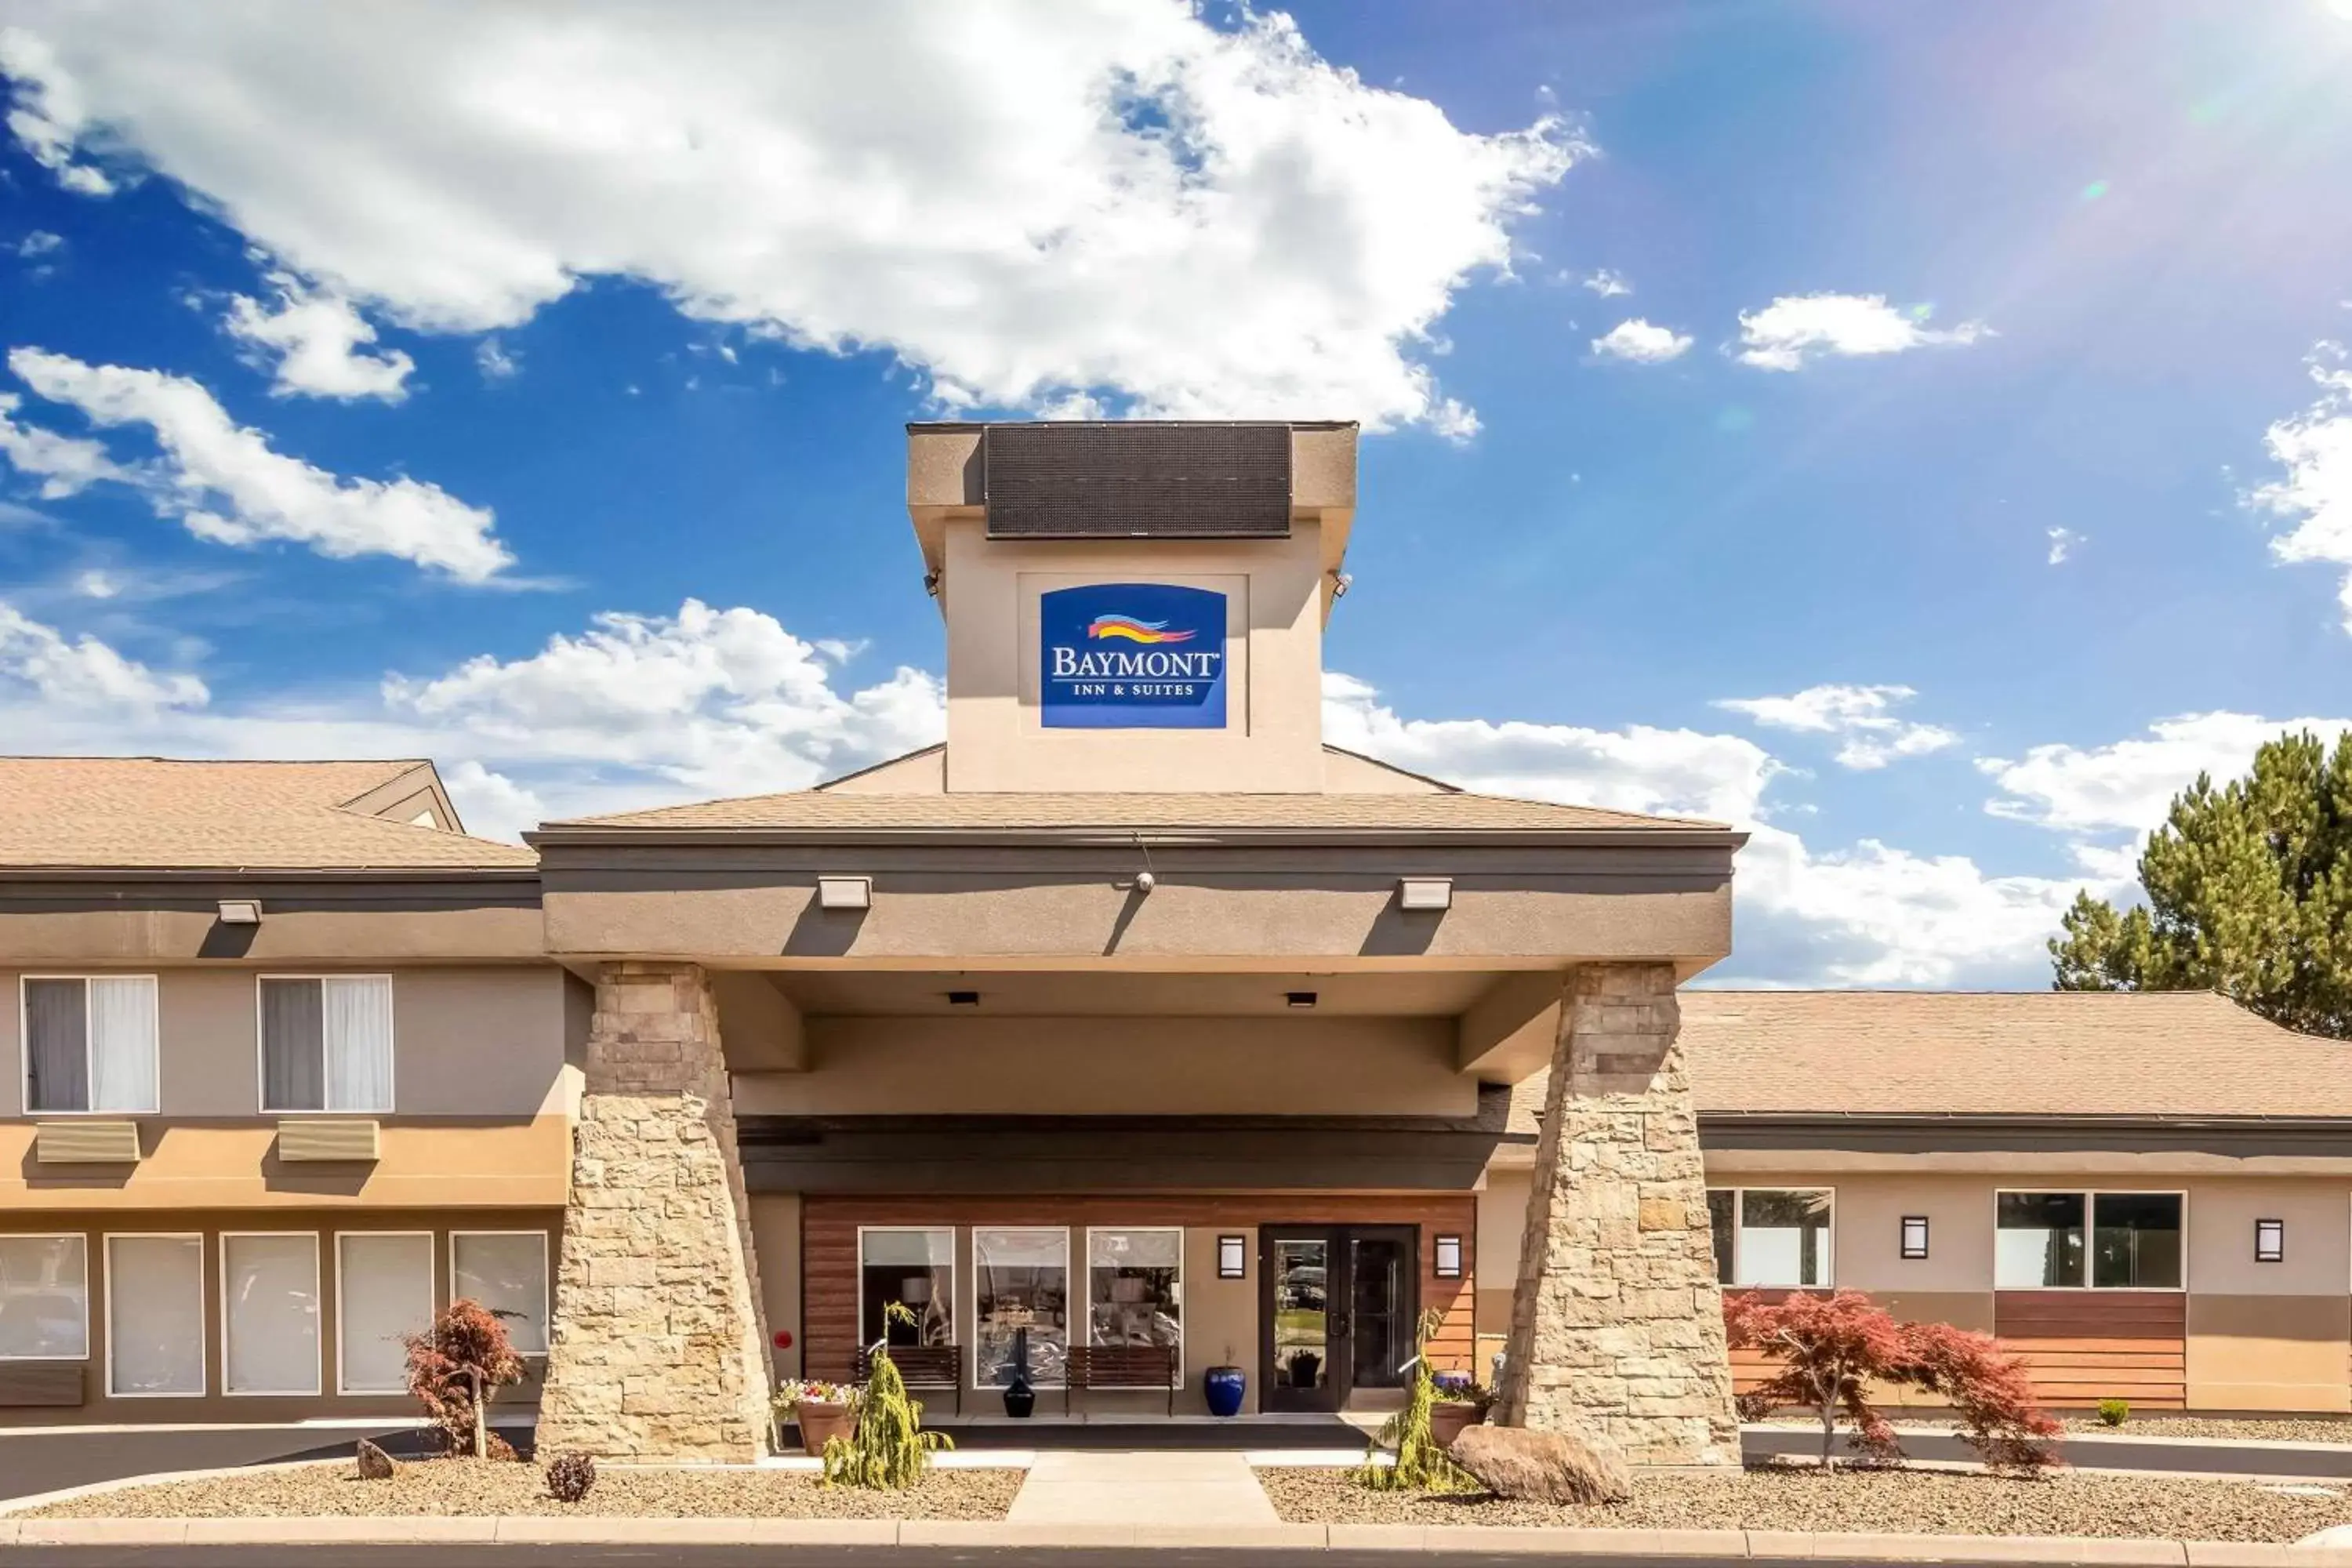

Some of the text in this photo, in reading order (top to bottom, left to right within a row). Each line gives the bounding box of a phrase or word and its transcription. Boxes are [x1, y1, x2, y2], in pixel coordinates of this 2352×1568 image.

[1051, 647, 1218, 677] BAYMONT
[1073, 684, 1194, 695] INN & SUITES
